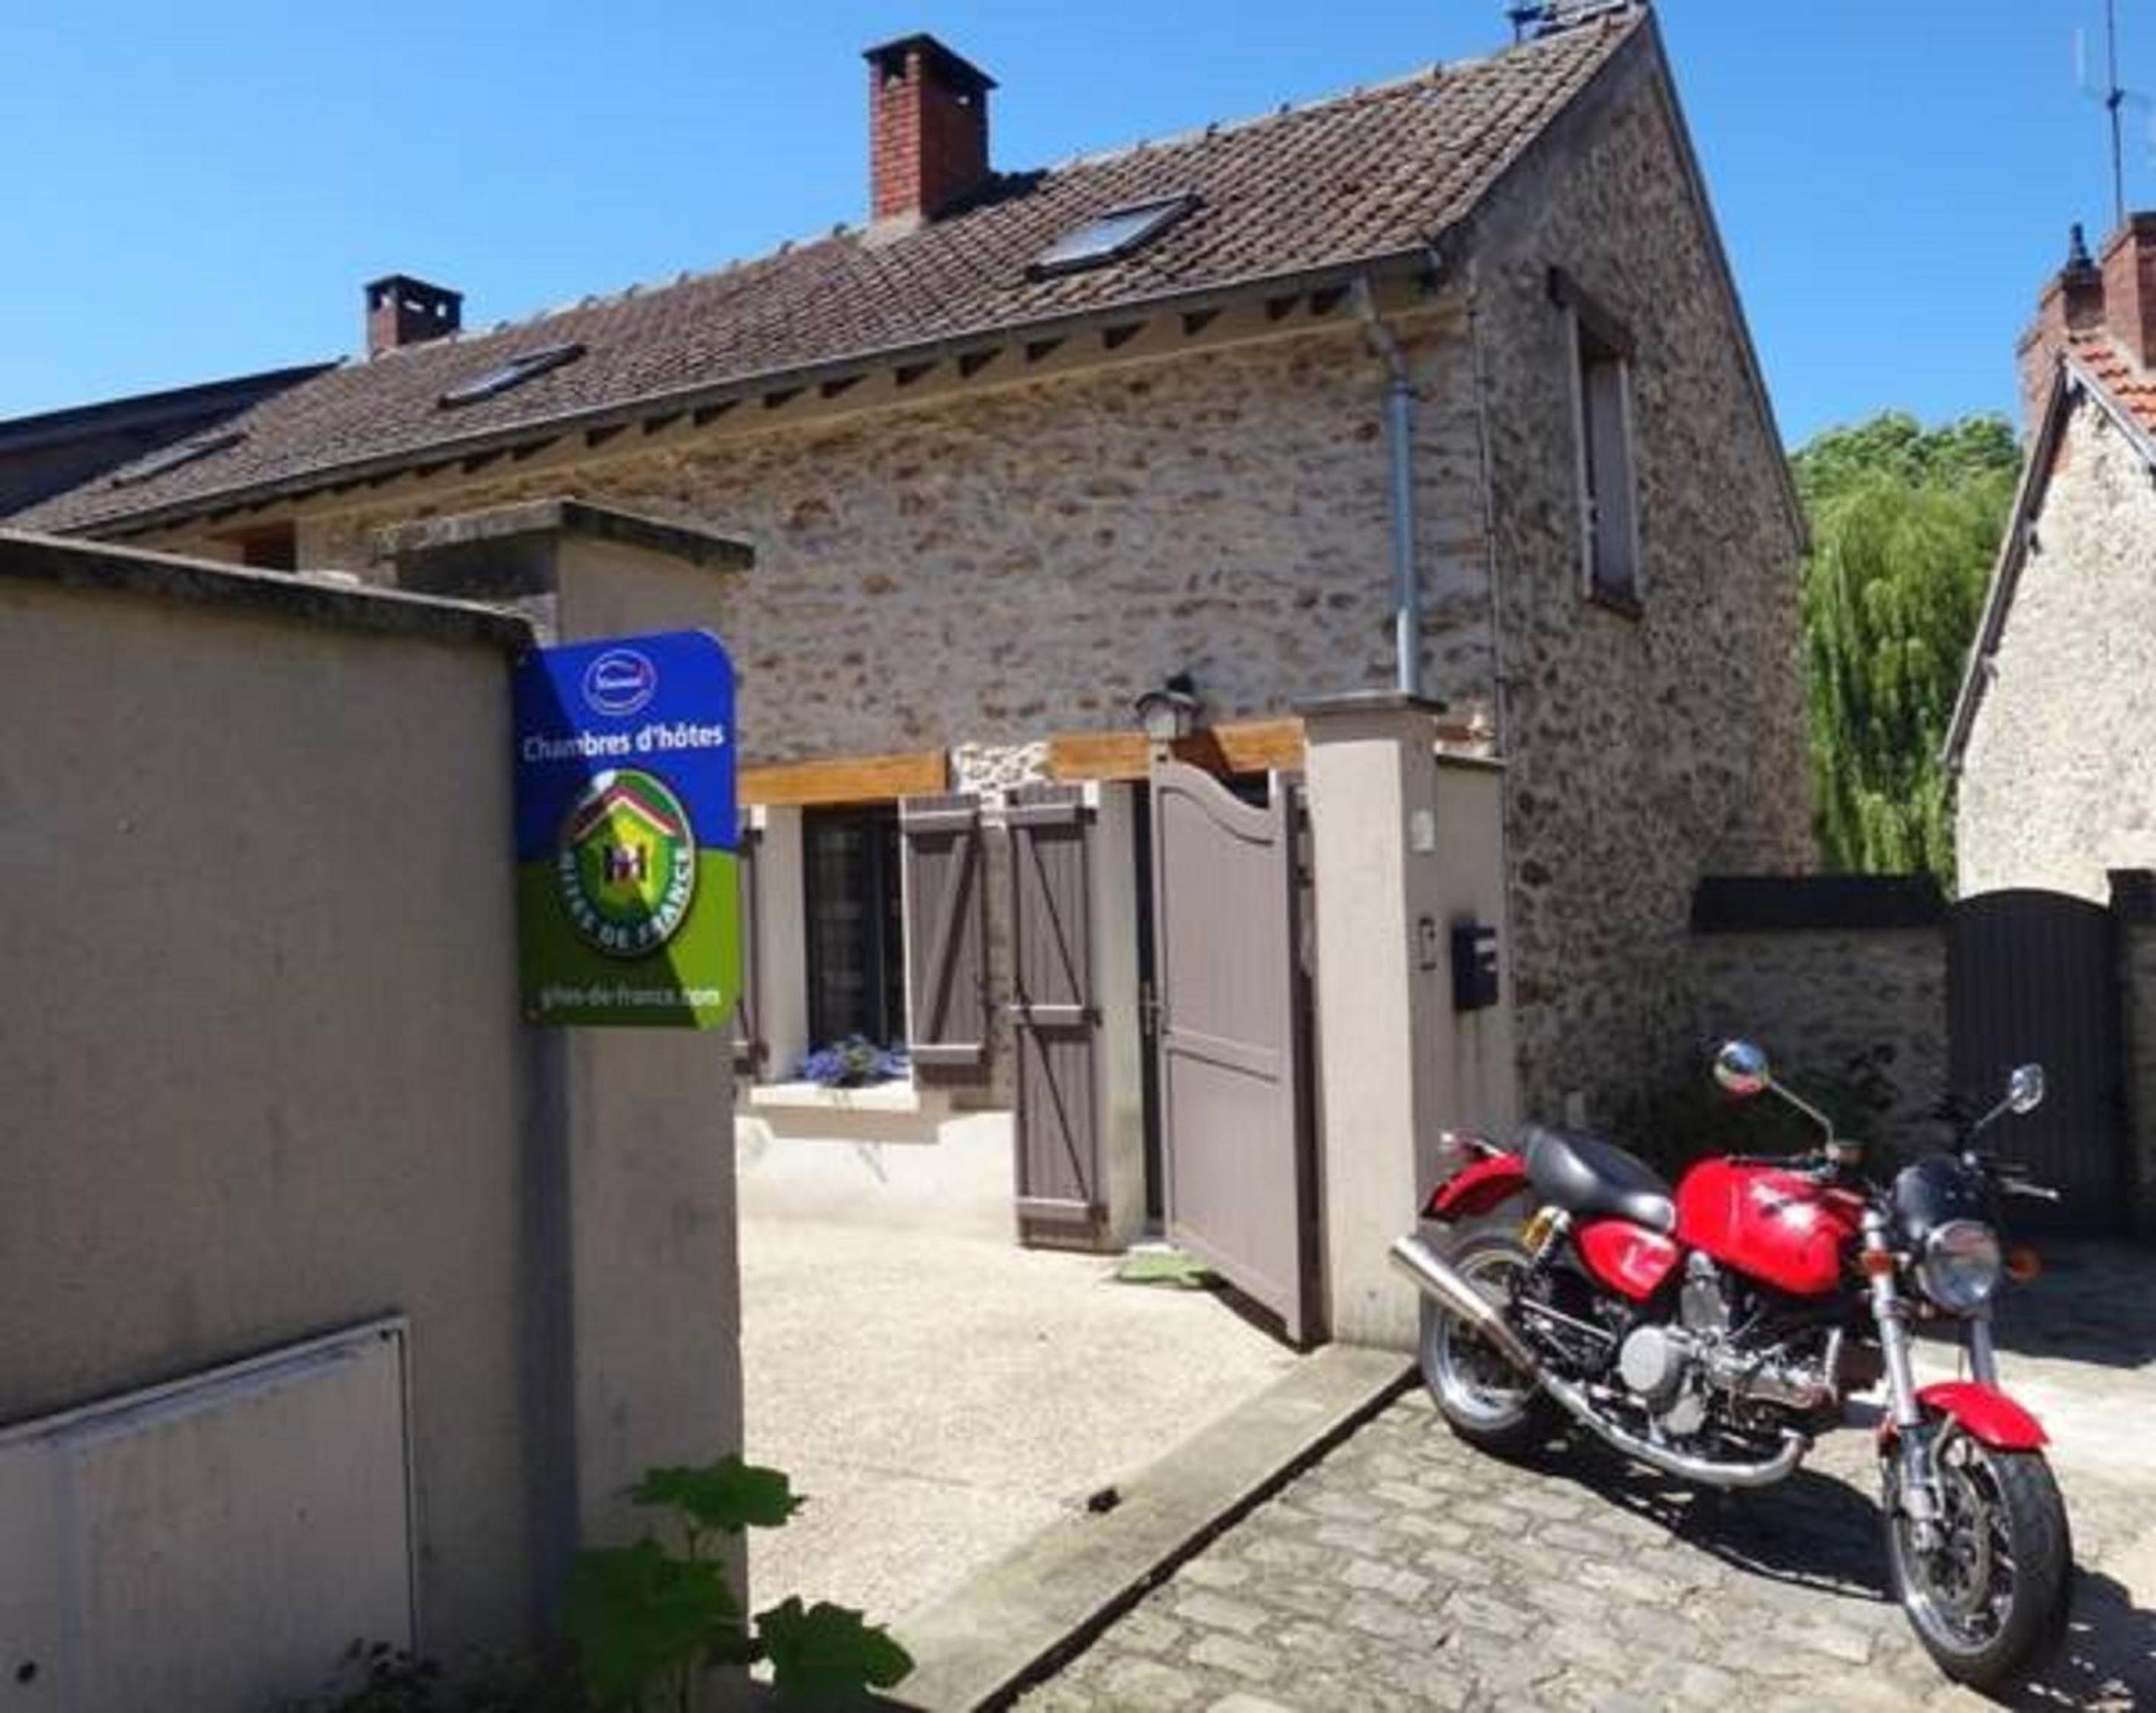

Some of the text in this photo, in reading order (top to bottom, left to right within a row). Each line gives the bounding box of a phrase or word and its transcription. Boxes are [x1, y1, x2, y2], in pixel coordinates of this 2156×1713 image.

[523, 722, 725, 761] Chambres d'hôtes
[598, 923, 629, 949] DE
